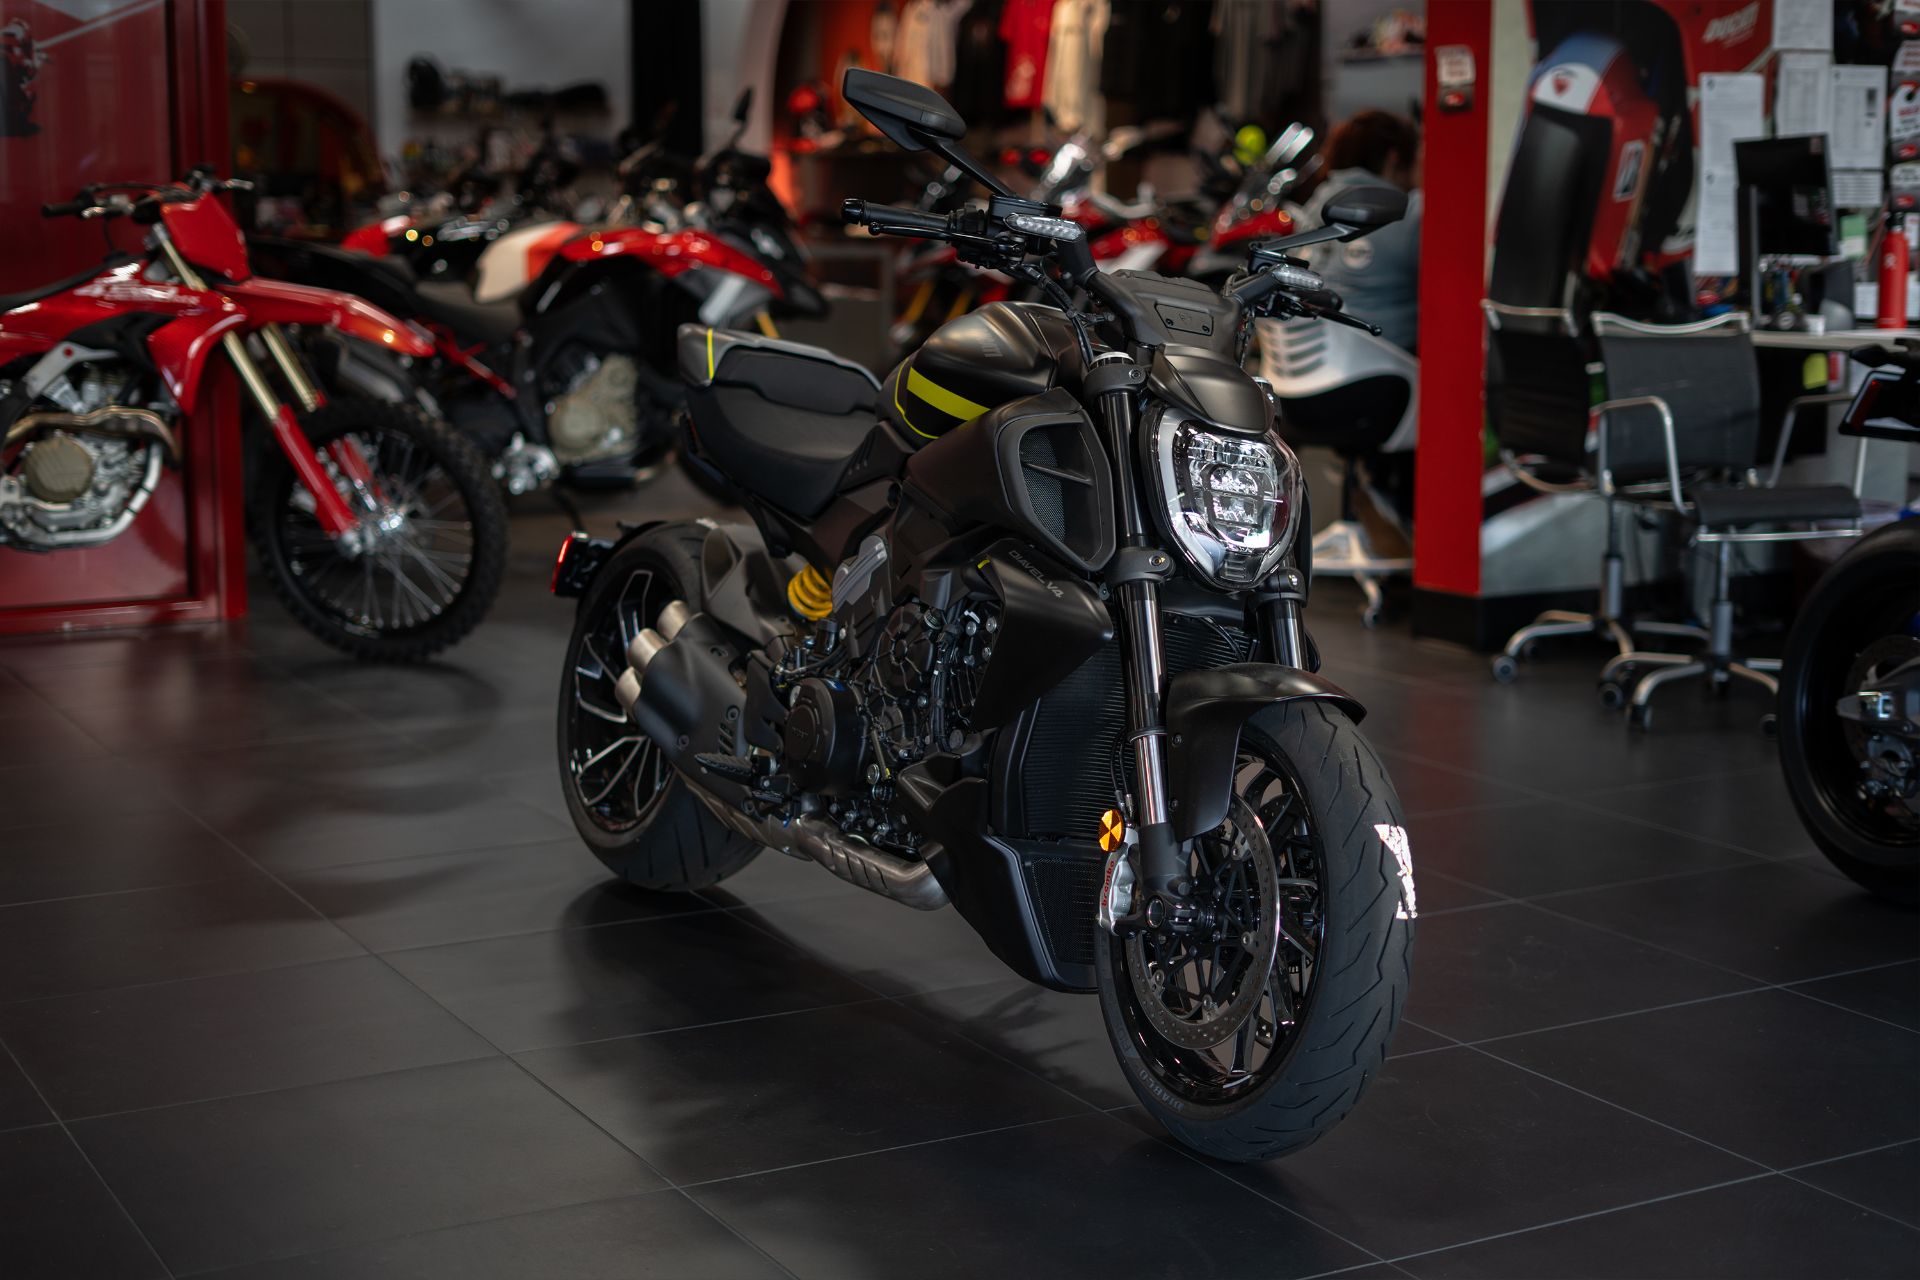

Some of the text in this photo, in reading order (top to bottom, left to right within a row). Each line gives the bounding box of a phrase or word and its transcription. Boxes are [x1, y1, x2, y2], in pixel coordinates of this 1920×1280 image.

[1008, 550, 1064, 598] DIAVEL V4
[1101, 860, 1115, 907] brembo
[1139, 1068, 1185, 1112] DIABLO
